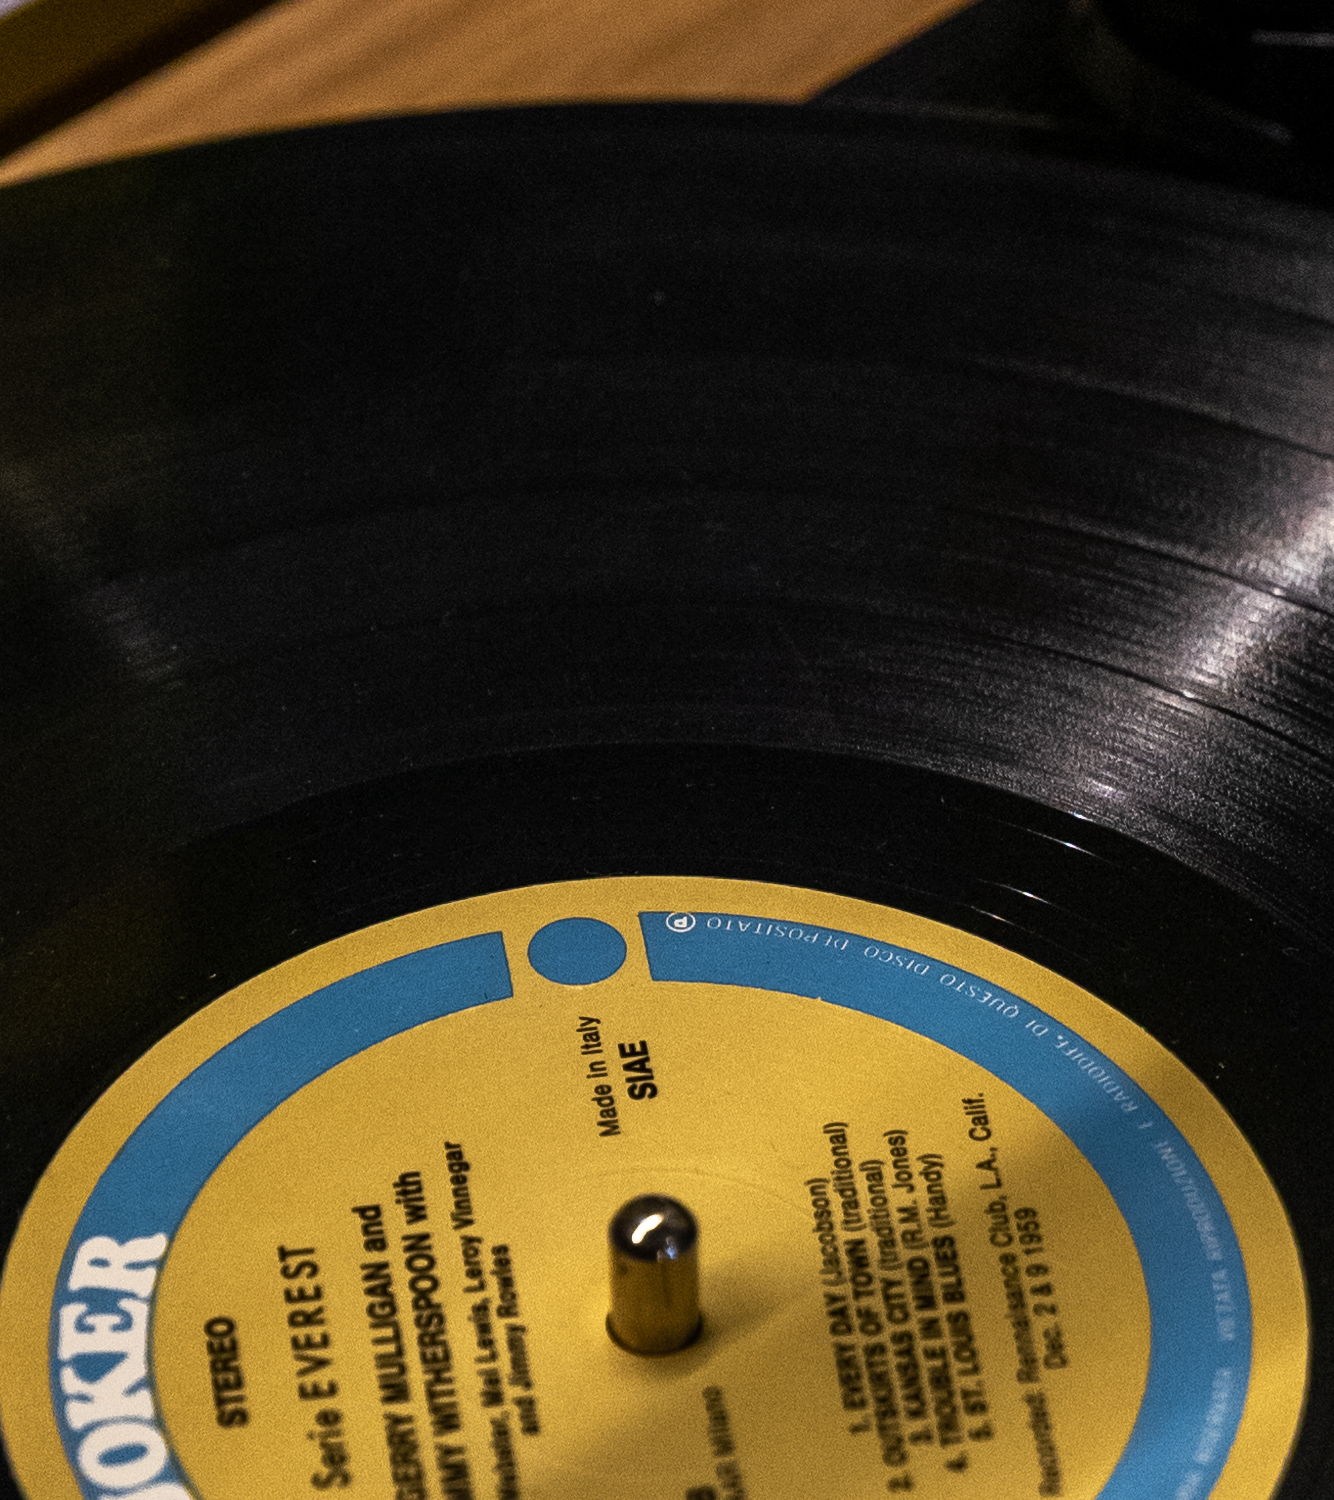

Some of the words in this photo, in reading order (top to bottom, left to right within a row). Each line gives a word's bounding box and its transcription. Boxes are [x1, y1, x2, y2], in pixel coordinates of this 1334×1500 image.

[707, 915, 850, 951] DEPOSITATO
[863, 944, 931, 976] DISCO
[939, 973, 1020, 1019] QUESTO
[576, 1016, 603, 1055] Italy
[1025, 1019, 1049, 1038] DI
[586, 1060, 608, 1079] in
[617, 1039, 658, 1101] SIAE
[591, 1084, 622, 1137] Made
[961, 1092, 992, 1142] Calif.
[444, 1141, 475, 1230] Vinnegar
[822, 1122, 867, 1232] (traditional)
[882, 1129, 915, 1194] Jones)
[917, 1153, 957, 1228] (Handy)
[975, 1147, 1003, 1190] L.A.,
[392, 1171, 427, 1225] with
[859, 1159, 904, 1272] (traditional)
[984, 1195, 1014, 1248] Club,
[351, 1204, 388, 1252] and
[804, 1178, 847, 1287] (Jacobson)
[1013, 1207, 1044, 1256] 1959
[460, 1235, 487, 1293] Leroy
[490, 1243, 519, 1318] Rowles
[844, 1238, 876, 1301] TOWN
[906, 1256, 938, 1311] MIND
[931, 1235, 966, 1305] BLUES
[1025, 1263, 1049, 1278] 9
[277, 1244, 338, 1401] EVEREST
[823, 1291, 853, 1337] DAY
[855, 1306, 883, 1337] OF
[879, 1276, 911, 1325] CITY
[917, 1315, 943, 1340] IN
[1032, 1303, 1058, 1317] 2
[360, 1261, 409, 1405] MULLIGAN
[401, 1232, 461, 1437] WITHERSPOON
[506, 1323, 533, 1391] Jimmy
[946, 1309, 982, 1378] LOUIS
[204, 1316, 249, 1428] STEREO
[834, 1342, 867, 1411] EVERY
[890, 1330, 928, 1421] KANSAS
[923, 1345, 964, 1448] TROUBLE
[514, 1395, 540, 1436] and
[863, 1341, 910, 1468] OUTSKIRTS
[306, 1407, 351, 1489] Serie
